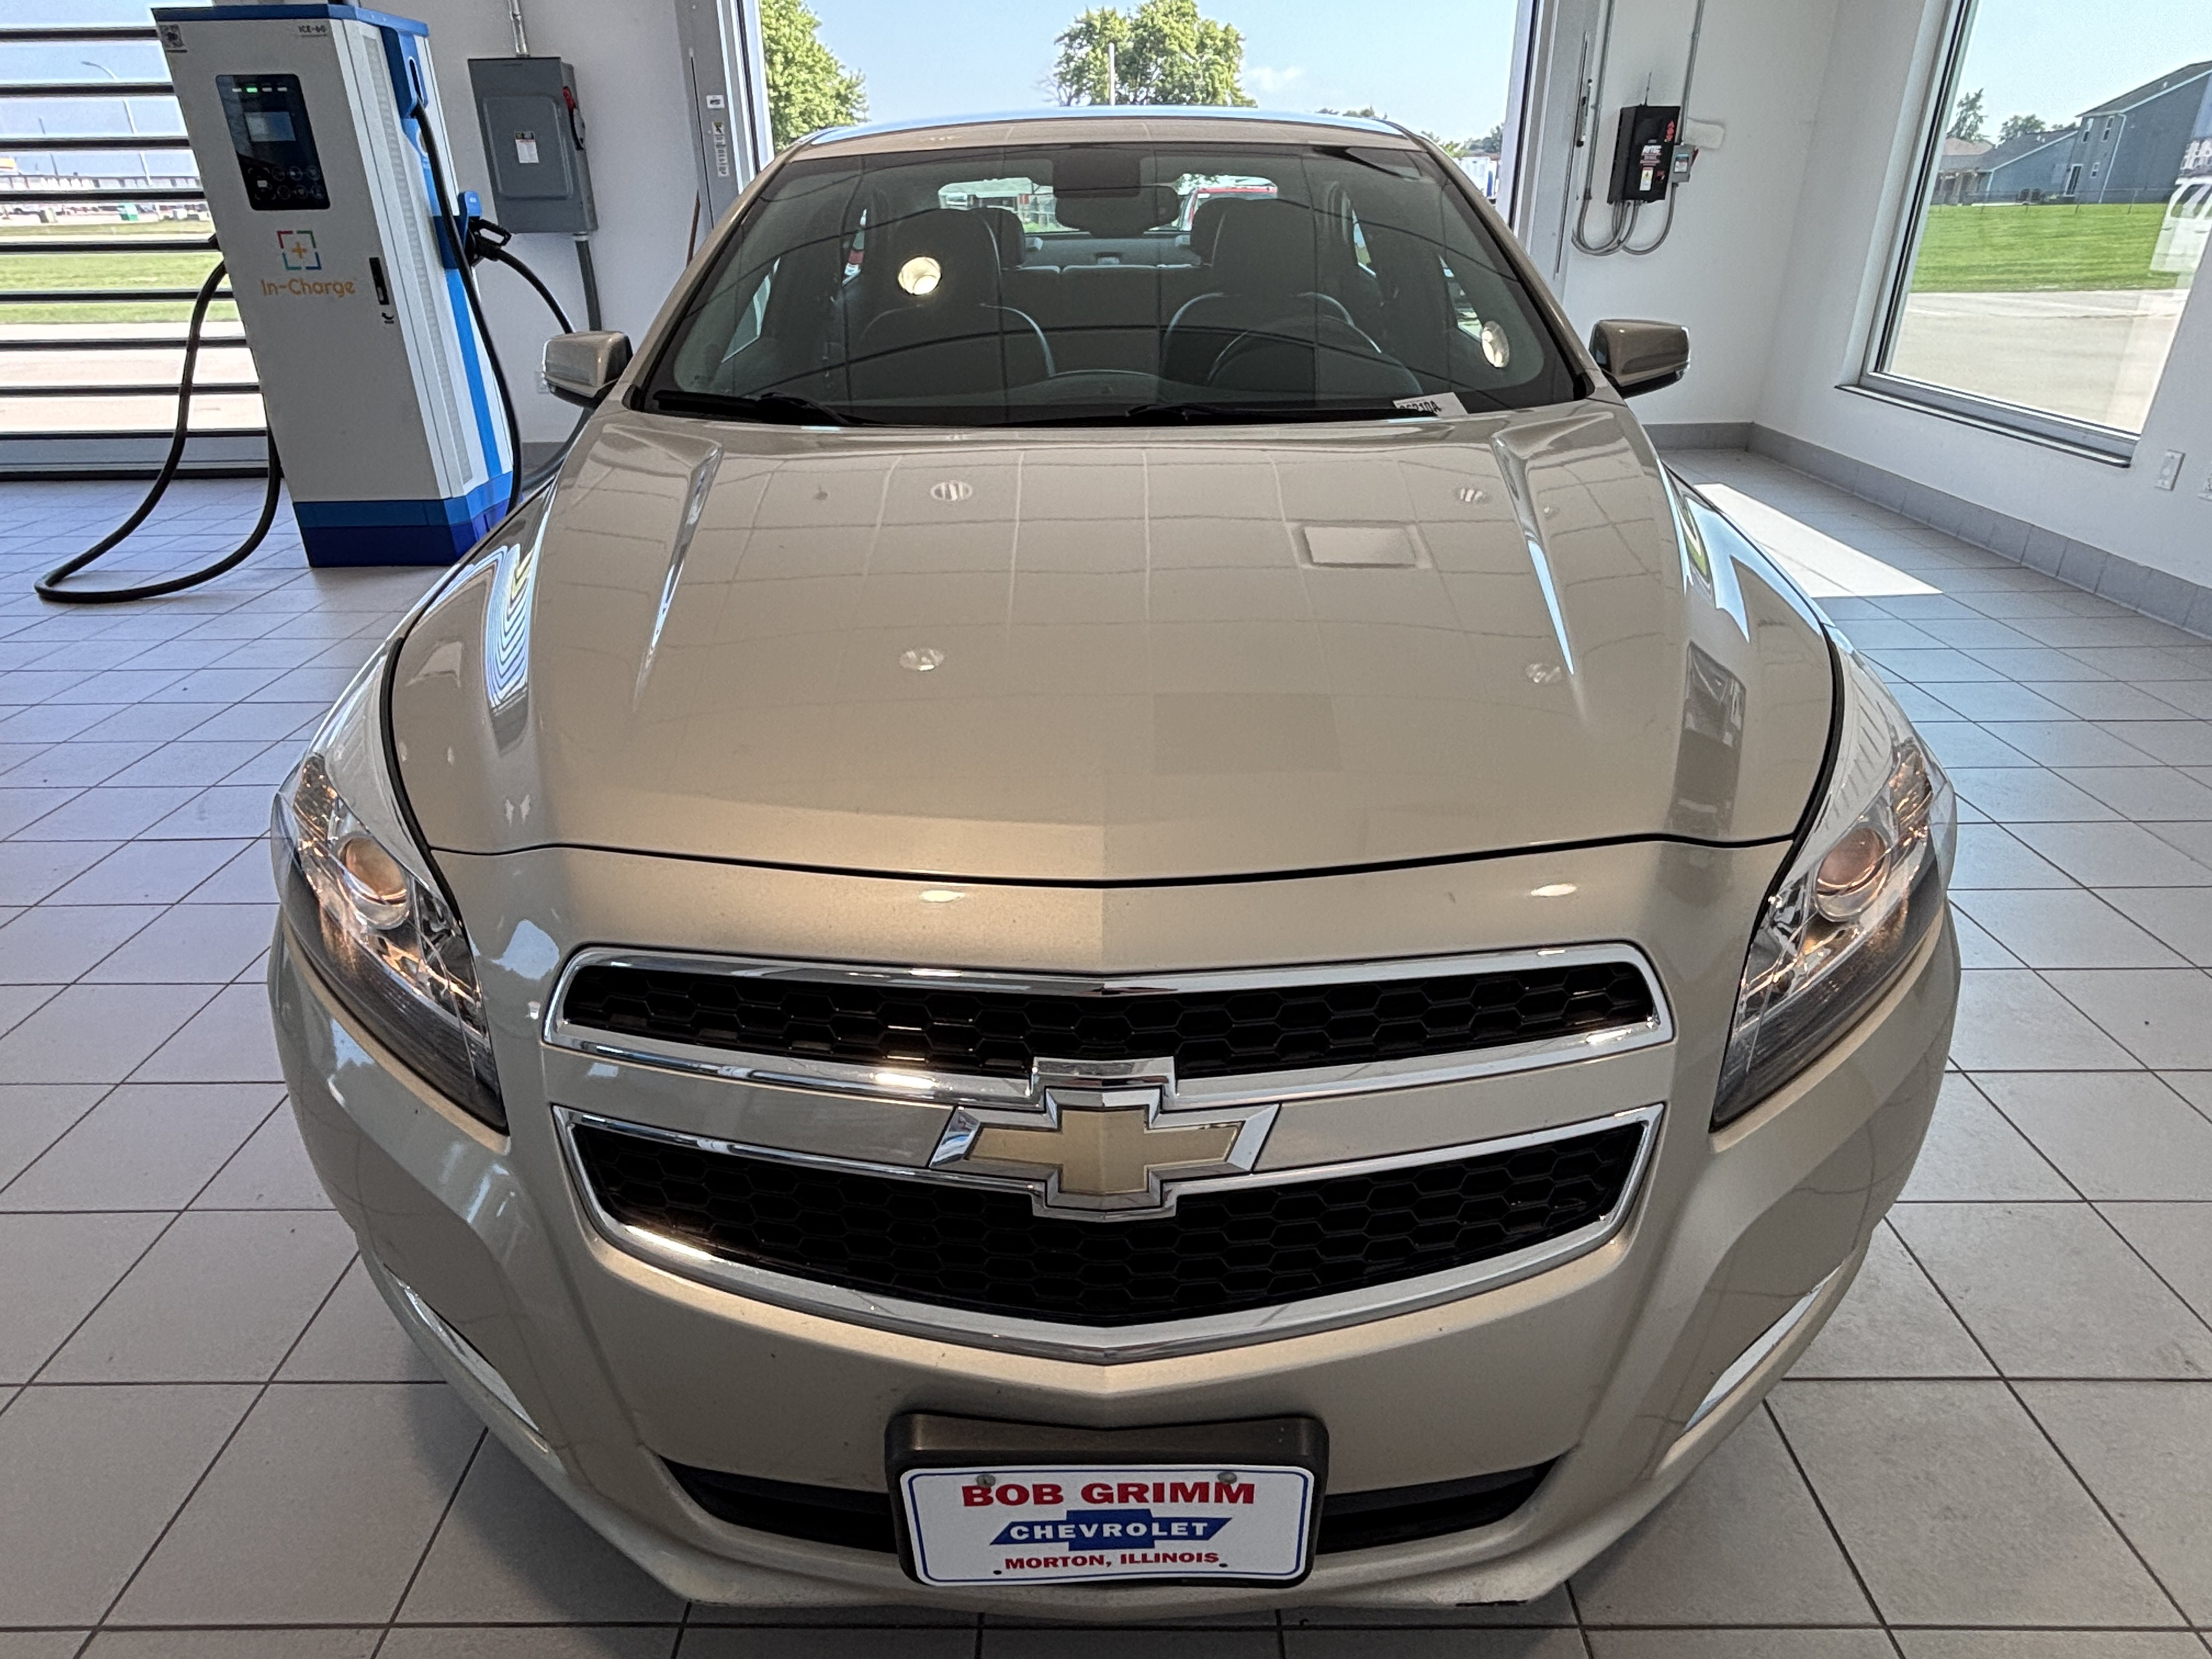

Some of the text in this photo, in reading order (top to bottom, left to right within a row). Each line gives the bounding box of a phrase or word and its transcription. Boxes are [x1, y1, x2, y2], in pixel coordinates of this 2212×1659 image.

[260, 278, 356, 298] In-Charge
[962, 1481, 1255, 1506] BOB GRIMM
[1010, 1522, 1208, 1540] CHEVROLET
[1005, 1552, 1220, 1569] MORTON, ILLINOIS
